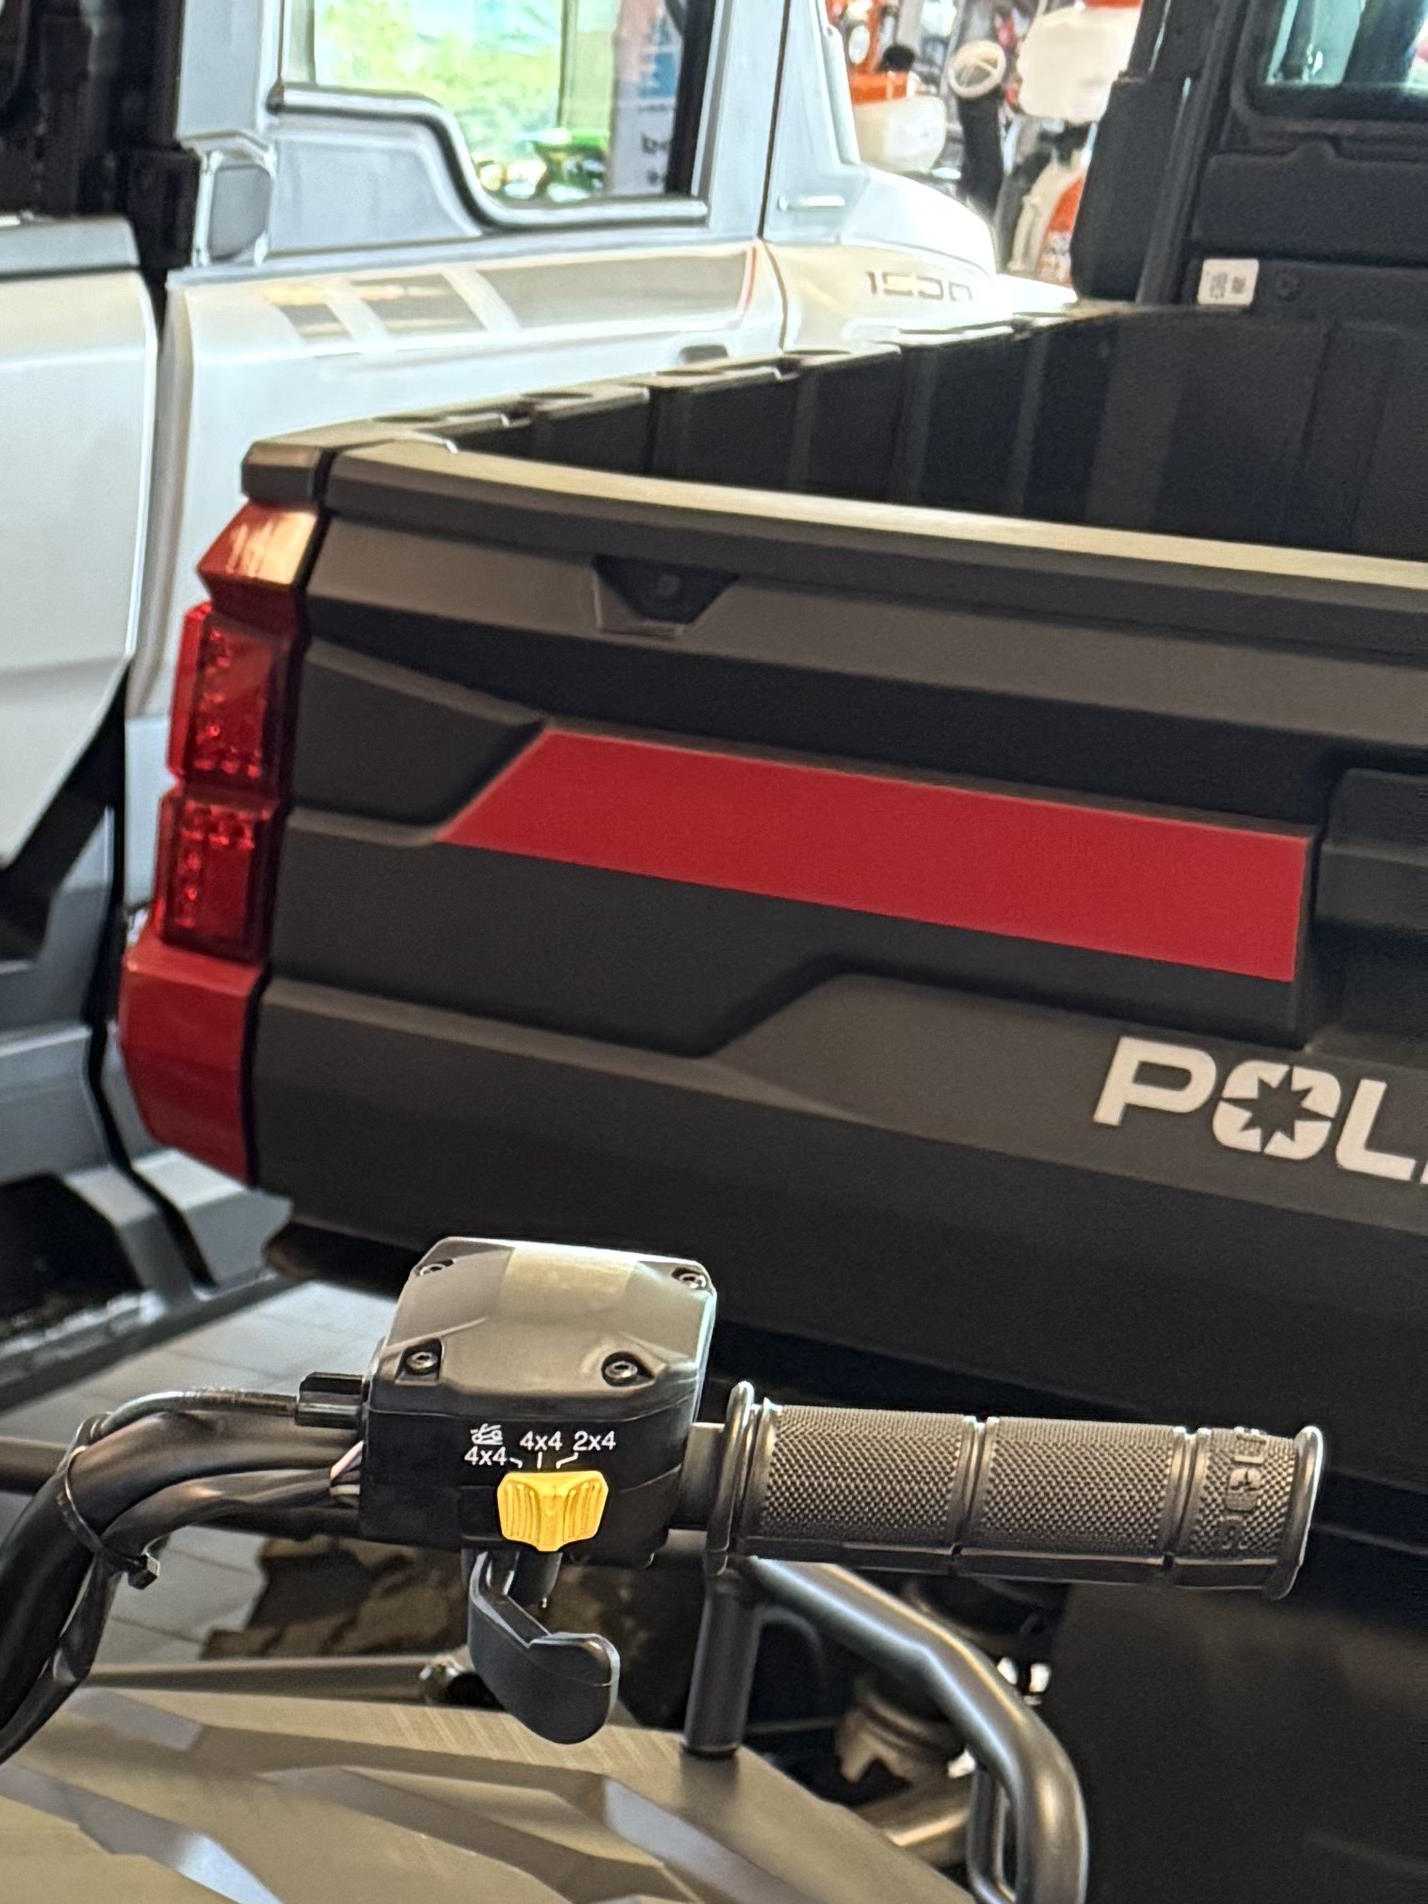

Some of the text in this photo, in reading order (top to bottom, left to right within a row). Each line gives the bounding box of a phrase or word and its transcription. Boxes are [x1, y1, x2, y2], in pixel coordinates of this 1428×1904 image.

[1093, 1036, 1428, 1185] POL
[520, 1431, 616, 1451] 4x4 2x4
[464, 1446, 507, 1467] 4x4
